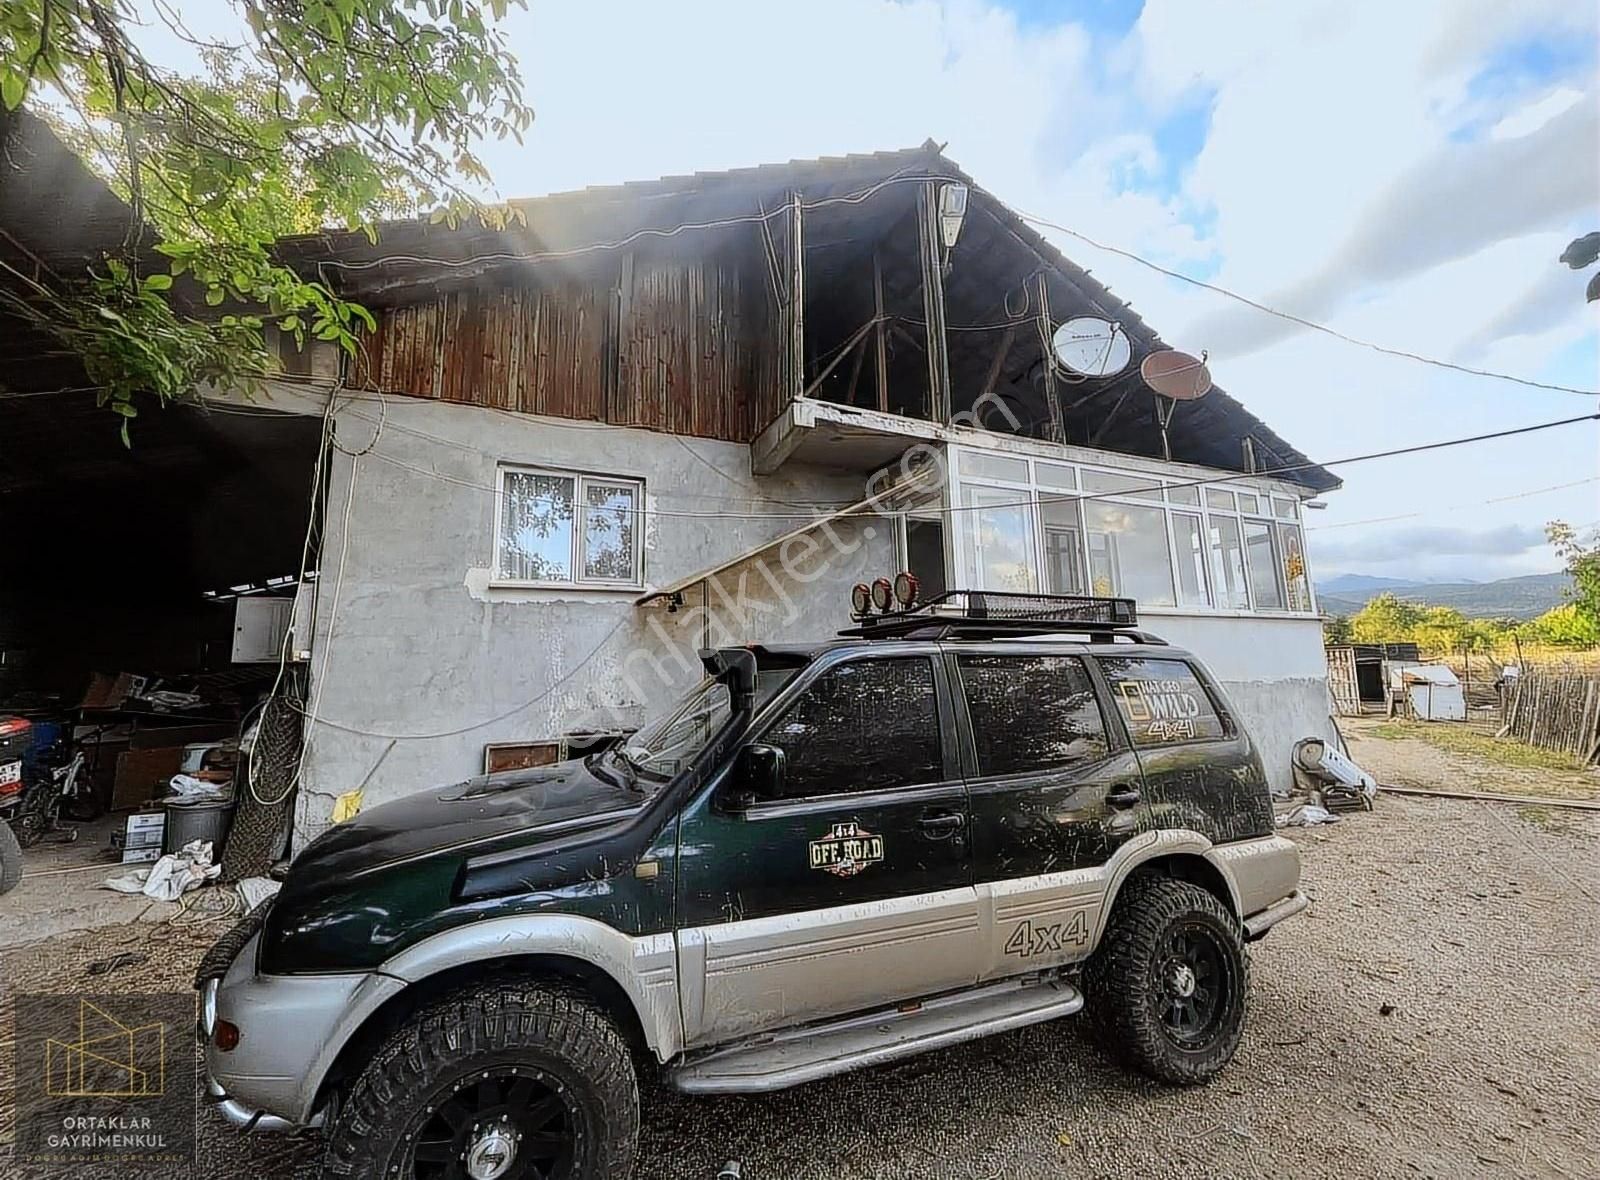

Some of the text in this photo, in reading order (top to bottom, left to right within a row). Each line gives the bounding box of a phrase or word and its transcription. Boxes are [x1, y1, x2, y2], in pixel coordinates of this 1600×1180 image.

[1145, 693, 1199, 719] WILD
[1148, 719, 1195, 740] 4x4
[1004, 910, 1089, 957] 4x4
